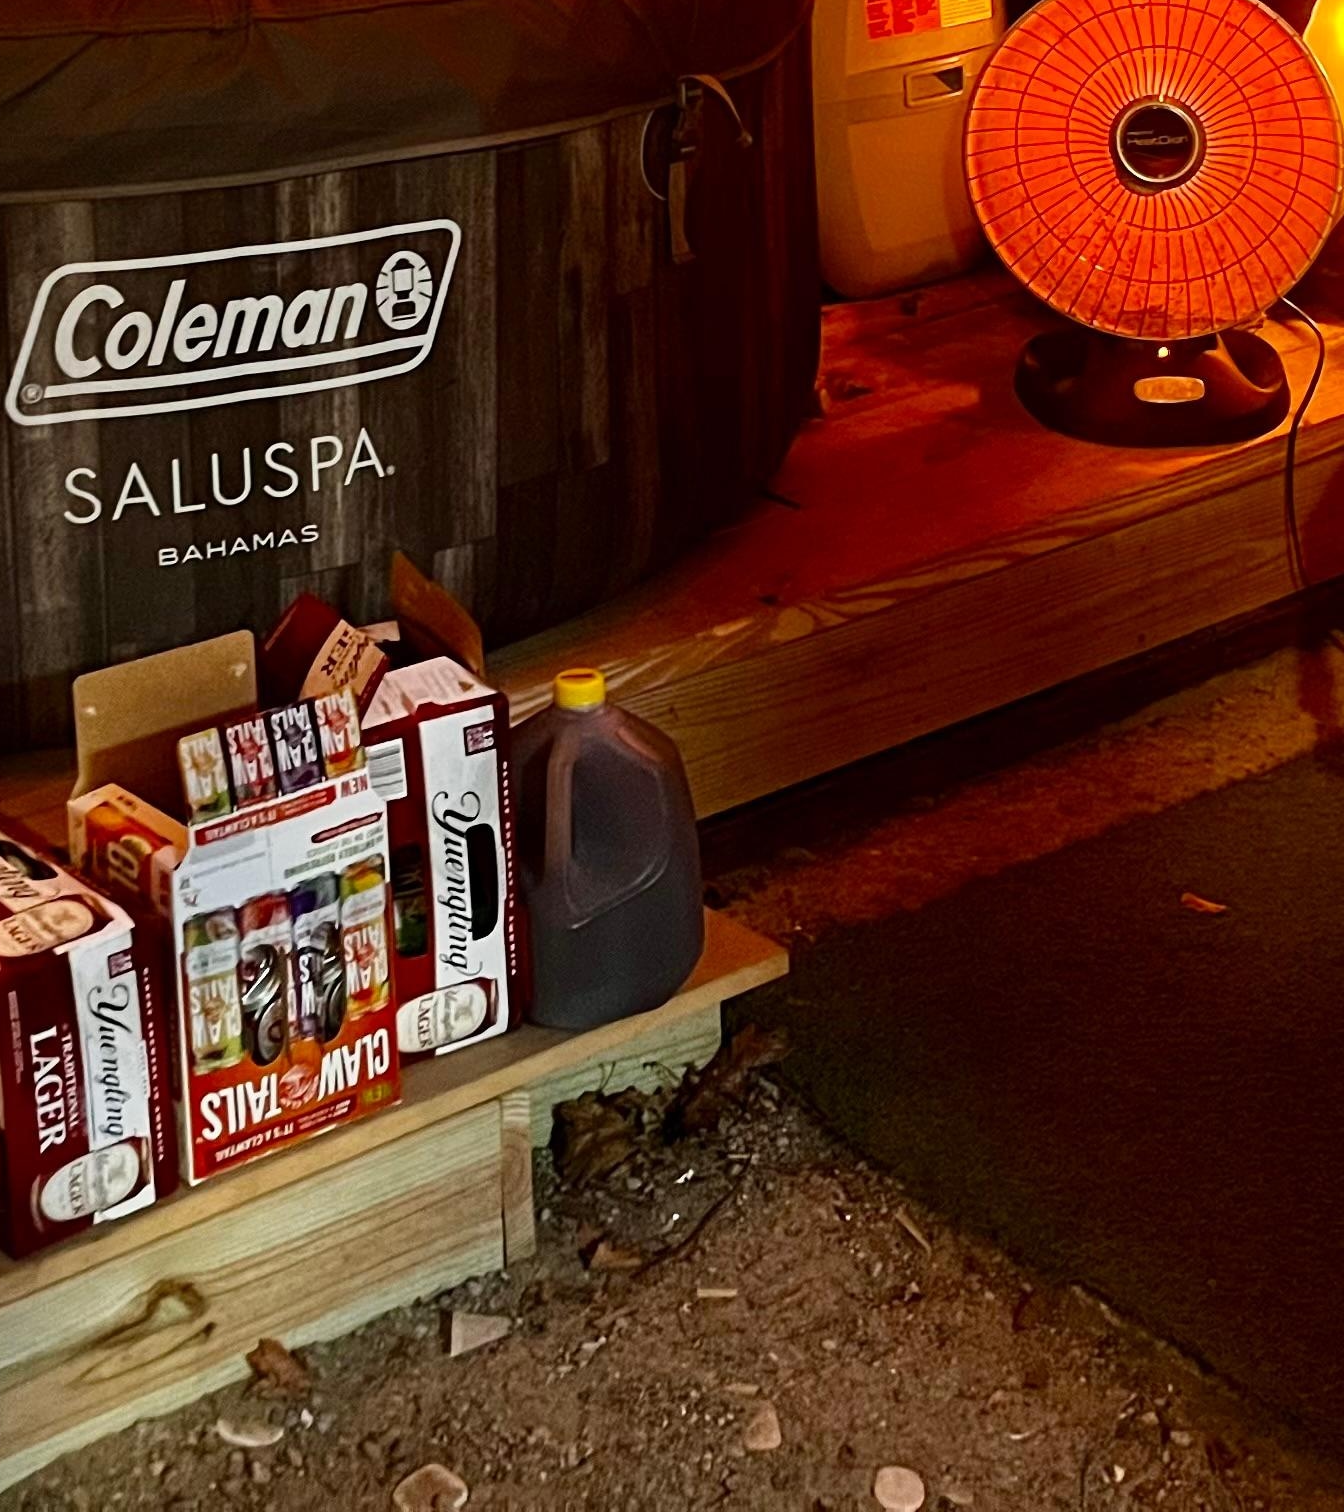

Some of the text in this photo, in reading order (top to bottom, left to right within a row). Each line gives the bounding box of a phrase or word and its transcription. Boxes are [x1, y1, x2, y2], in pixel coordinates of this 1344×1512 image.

[54, 278, 369, 382] Coleman
[63, 426, 388, 525] SALUSPA
[157, 523, 321, 567] BAHAMAS
[431, 790, 483, 977] Yuengling
[87, 983, 133, 1137] Yuengling
[317, 1028, 391, 1101] CLAW
[417, 994, 435, 1050] LAGER
[29, 1025, 67, 1155] LAGER
[60, 1032, 81, 1130] TRADITIONAL
[200, 1072, 283, 1142] TAILS
